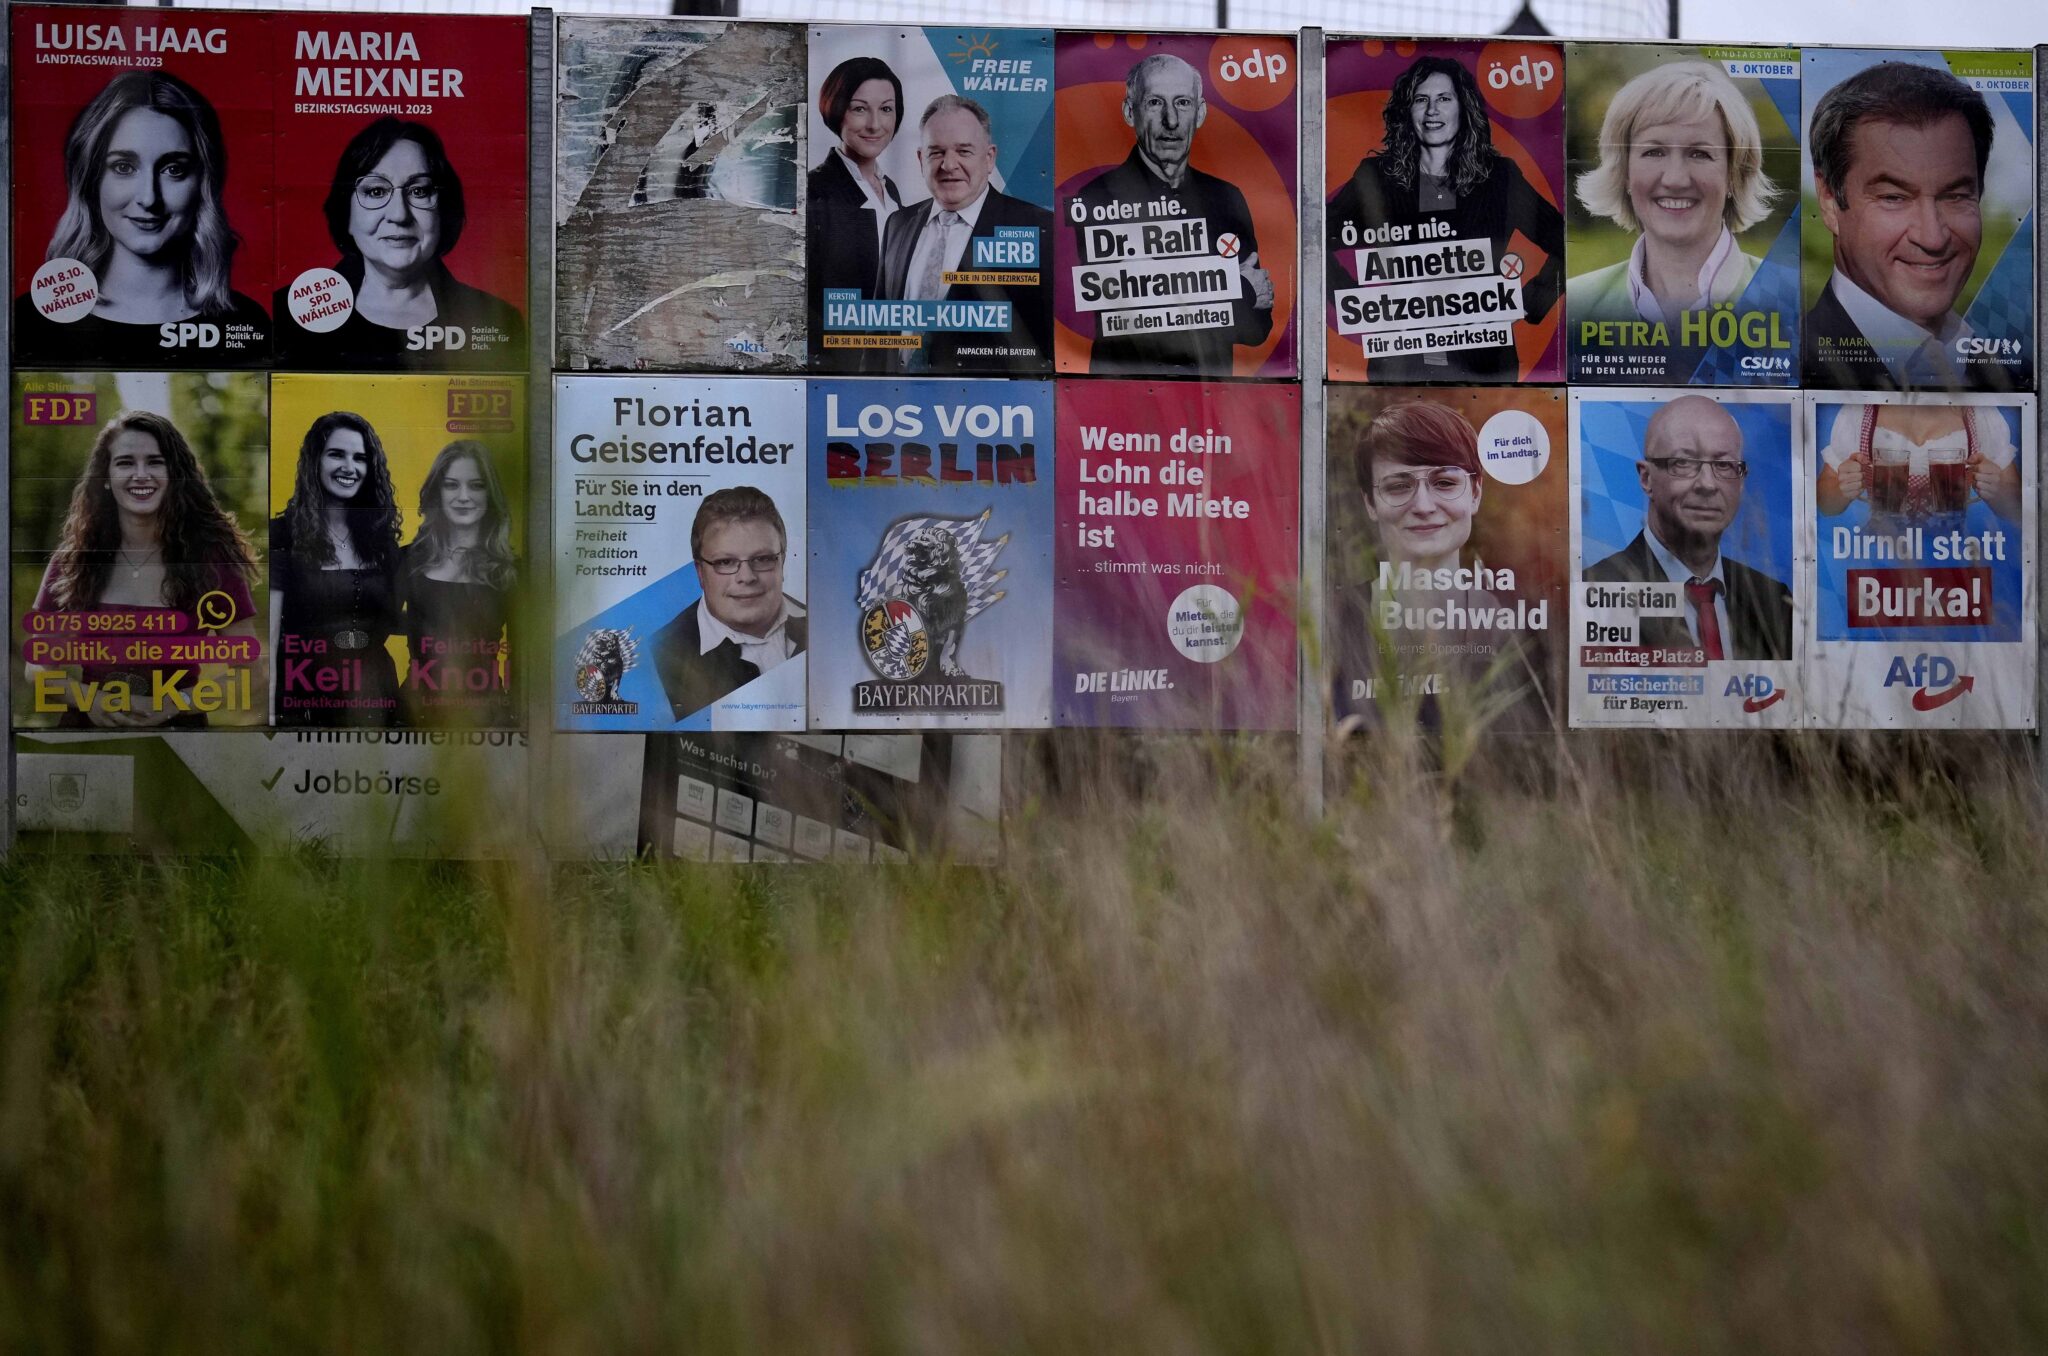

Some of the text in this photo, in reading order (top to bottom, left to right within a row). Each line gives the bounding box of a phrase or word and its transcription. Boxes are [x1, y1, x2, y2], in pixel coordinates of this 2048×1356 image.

[36, 23, 227, 54] LUISA HAAG
[295, 31, 421, 61] MARIA
[36, 54, 163, 67] LANDTAGSWAHL 2023
[972, 59, 1033, 75] FREIE
[1220, 48, 1287, 83] ödp
[1730, 64, 1794, 75] 8. OKTOBER
[295, 67, 465, 98] MEIXNER
[964, 73, 1048, 92] WÄHLER
[1488, 55, 1554, 91] ödp
[1957, 68, 2031, 76] LANDTAGSWAHL
[1975, 81, 2030, 90] 8. OKTOBER
[295, 103, 433, 115] BEZIRKSTAGSWAHL 2023
[1071, 195, 1187, 223] Ö oder nie.
[999, 230, 1035, 239] CHRISTIAN
[1092, 221, 1204, 259] Dr. Ralf
[1342, 217, 1458, 246] Ö oder nie.
[978, 240, 1035, 264] NERB
[1365, 245, 1486, 282] Annette
[36, 266, 86, 291] AM 8.10.
[293, 276, 341, 300] AM 8.10.
[945, 273, 1037, 284] FÜR SIE IN DEN BEZIRKSTAG
[1080, 267, 1228, 303] Schramm
[53, 282, 76, 298] SPD
[309, 292, 330, 308] SPD
[828, 292, 857, 301] KERSTIN
[41, 288, 97, 315] WÄHLEN!
[299, 299, 352, 325] WÄHLEN!
[1341, 282, 1518, 326] Setzensack
[828, 303, 1008, 328] HAIMERL-KUNZE
[1107, 308, 1230, 332] für den Landtag
[1581, 302, 1791, 349] PETRA HÖGL
[159, 322, 221, 348] SPD
[226, 324, 254, 333] Soziale
[226, 333, 265, 342] Politik für
[406, 325, 467, 351] SPD
[471, 326, 499, 335] Soziale
[226, 342, 246, 351] Dich.
[471, 335, 510, 344] Politik für
[471, 343, 492, 352] Dich.
[826, 336, 919, 347] FÜR SIE IN DEN BEZIRKSTAG
[1367, 329, 1508, 354] für den Bezirkstag
[1818, 336, 1836, 347] DR.
[1956, 337, 2000, 355] CSU
[957, 346, 1036, 357] ANPACKEN FÜR BAYERN
[1581, 353, 1667, 364] FÜR UNS WIEDER
[1581, 367, 1665, 376] IN DEN LANDTAG
[1741, 356, 1775, 370] CSU
[24, 382, 46, 392] Alle
[30, 398, 92, 421] FDP
[452, 394, 507, 414] FDP
[614, 397, 752, 428] Florian
[827, 394, 1034, 438] Los von
[570, 433, 794, 465] Geisenfelder
[1079, 426, 1232, 454] Wenn dein
[1494, 435, 1532, 447] Für dich
[1487, 448, 1542, 460] im Landtag.
[826, 441, 1038, 490] BERLIN
[1079, 458, 1204, 486] Lohn die
[575, 480, 703, 496] Für Sie in den
[575, 501, 657, 520] Landtag
[1078, 489, 1251, 520] halbe Miete
[576, 530, 627, 542] Freiheit
[1078, 521, 1115, 548] ist
[1832, 526, 2006, 561] Dirndl statt
[576, 547, 638, 559] Tradition
[576, 565, 647, 576] Fortschritt
[1094, 559, 1226, 576] stimmt was nicht.
[1379, 559, 1516, 592] Mascha
[1585, 587, 1677, 609] Christian
[1857, 576, 1982, 618] Burka!
[33, 614, 178, 631] 0175 9925 411
[1380, 599, 1549, 631] Buchwald
[1201, 623, 1240, 634] leisten
[1586, 621, 1632, 643] Breu
[33, 640, 251, 664] Politik, die zuhört
[284, 634, 328, 655] Eva
[1186, 636, 1228, 648] kannst.
[1585, 648, 1705, 666] Landtag Platz 8
[284, 659, 512, 692] Keil Knoll
[1883, 653, 1956, 687] AfD
[34, 669, 252, 712] Eva Keil
[1075, 672, 1108, 693] DIE
[1591, 677, 1700, 692] Mit Sicherheit
[1724, 674, 1774, 697] AfD
[283, 697, 397, 709] Direktkandidatin
[858, 684, 1001, 707] BAYERNPARTEI
[1111, 695, 1138, 704] Bayern
[1603, 696, 1688, 713] für Bayern.
[573, 702, 638, 715] BAYERNPARTEI
[680, 737, 705, 758] Was
[710, 749, 747, 772] suchst
[752, 762, 777, 783] Du?
[295, 769, 441, 796] Jobbörse
